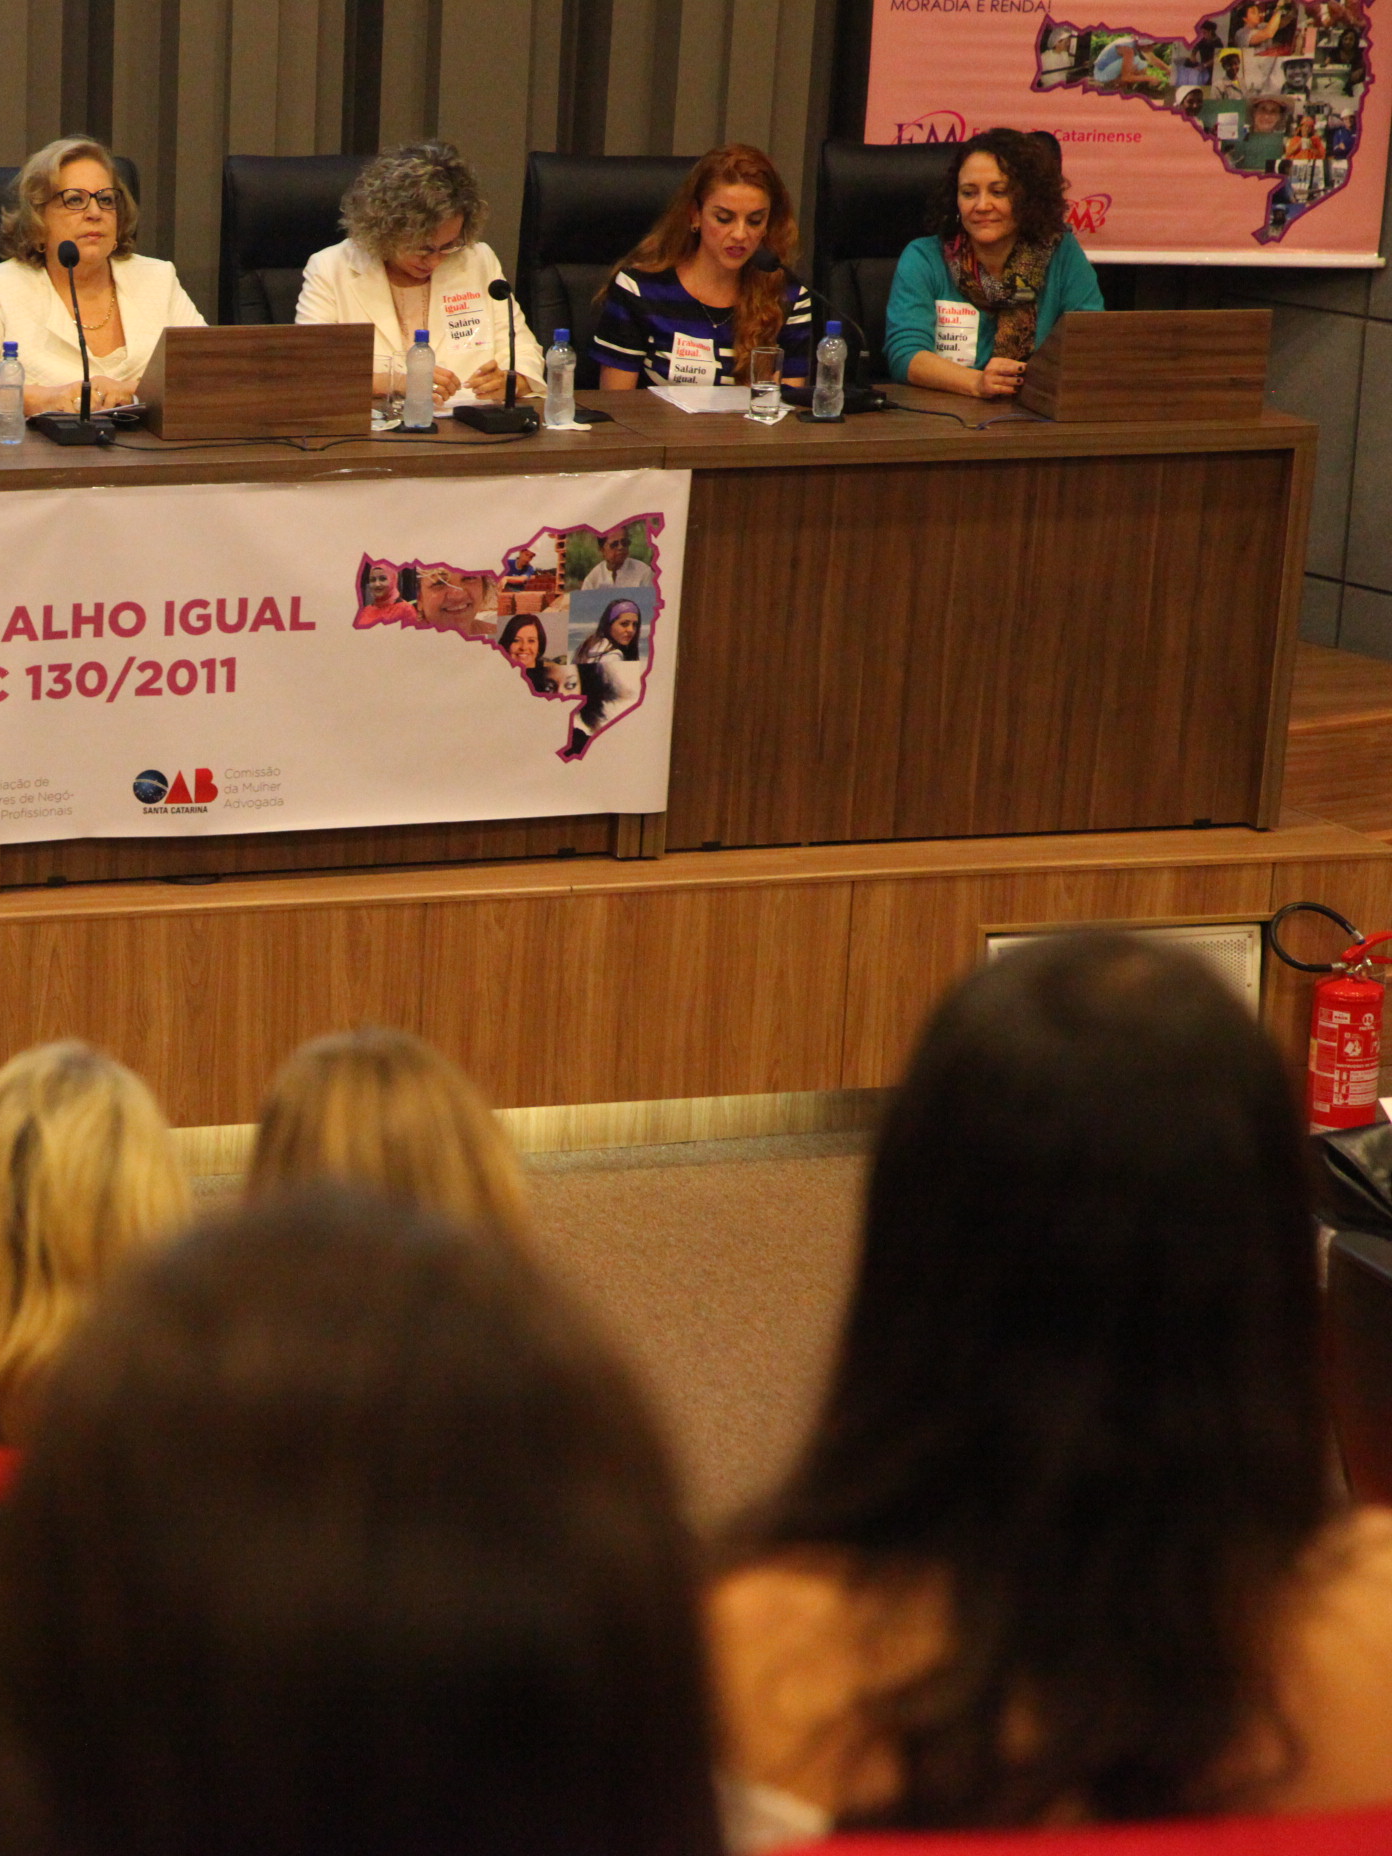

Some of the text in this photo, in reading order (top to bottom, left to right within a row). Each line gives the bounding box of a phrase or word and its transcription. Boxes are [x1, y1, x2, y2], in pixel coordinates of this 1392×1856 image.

[890, 0, 1052, 13] MORADIA E RENDA!
[1053, 129, 1142, 143] Catarinense
[443, 292, 481, 303] Trabalho
[445, 302, 470, 314] igual.
[938, 306, 977, 316] Trabalho
[448, 318, 481, 329] Salário
[938, 332, 968, 341] Salário
[676, 348, 702, 357] igual.
[936, 342, 961, 352] igual.
[674, 364, 707, 375] Salário
[673, 375, 698, 384] igual.
[164, 596, 316, 637] IGUAL
[25, 657, 237, 704] 130/2011
[224, 767, 281, 780] Comissão
[35, 776, 50, 788] de
[224, 782, 283, 795] da Mulher
[20, 793, 34, 804] de
[38, 790, 75, 804] Negó-
[224, 797, 285, 810] Advogada
[1, 805, 73, 821] Profissionais
[143, 806, 208, 815] SANTA CATARINA
